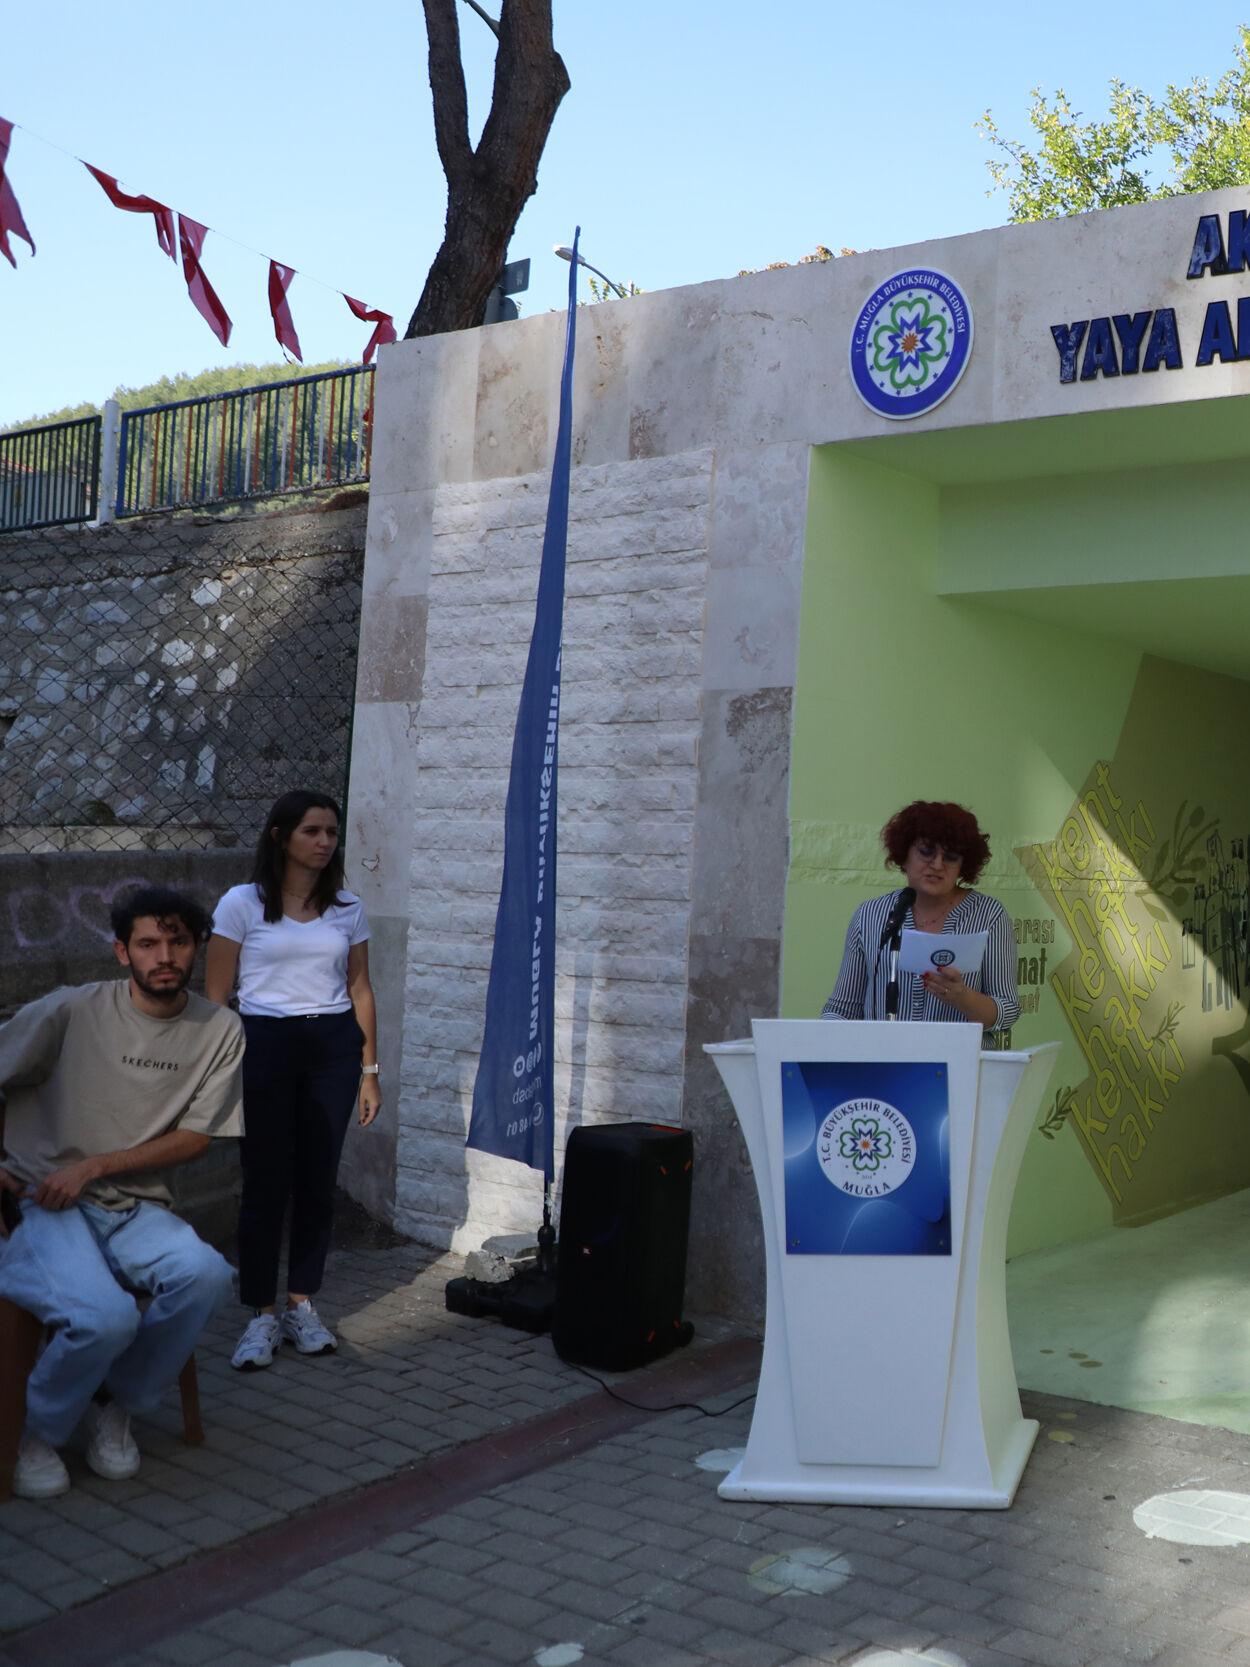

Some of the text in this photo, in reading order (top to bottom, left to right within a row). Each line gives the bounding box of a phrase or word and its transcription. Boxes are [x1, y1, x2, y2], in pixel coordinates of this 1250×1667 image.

[883, 273, 940, 297] BÜYÜKŞEHİR
[1050, 307, 1183, 384] YAYA
[1017, 947, 1048, 986] nat
[121, 1055, 179, 1071] SKECHERS
[823, 1100, 880, 1139] BÜYÜKŞEHİR
[821, 1143, 831, 1163] T.C.
[842, 1181, 891, 1196] MUĞLA
